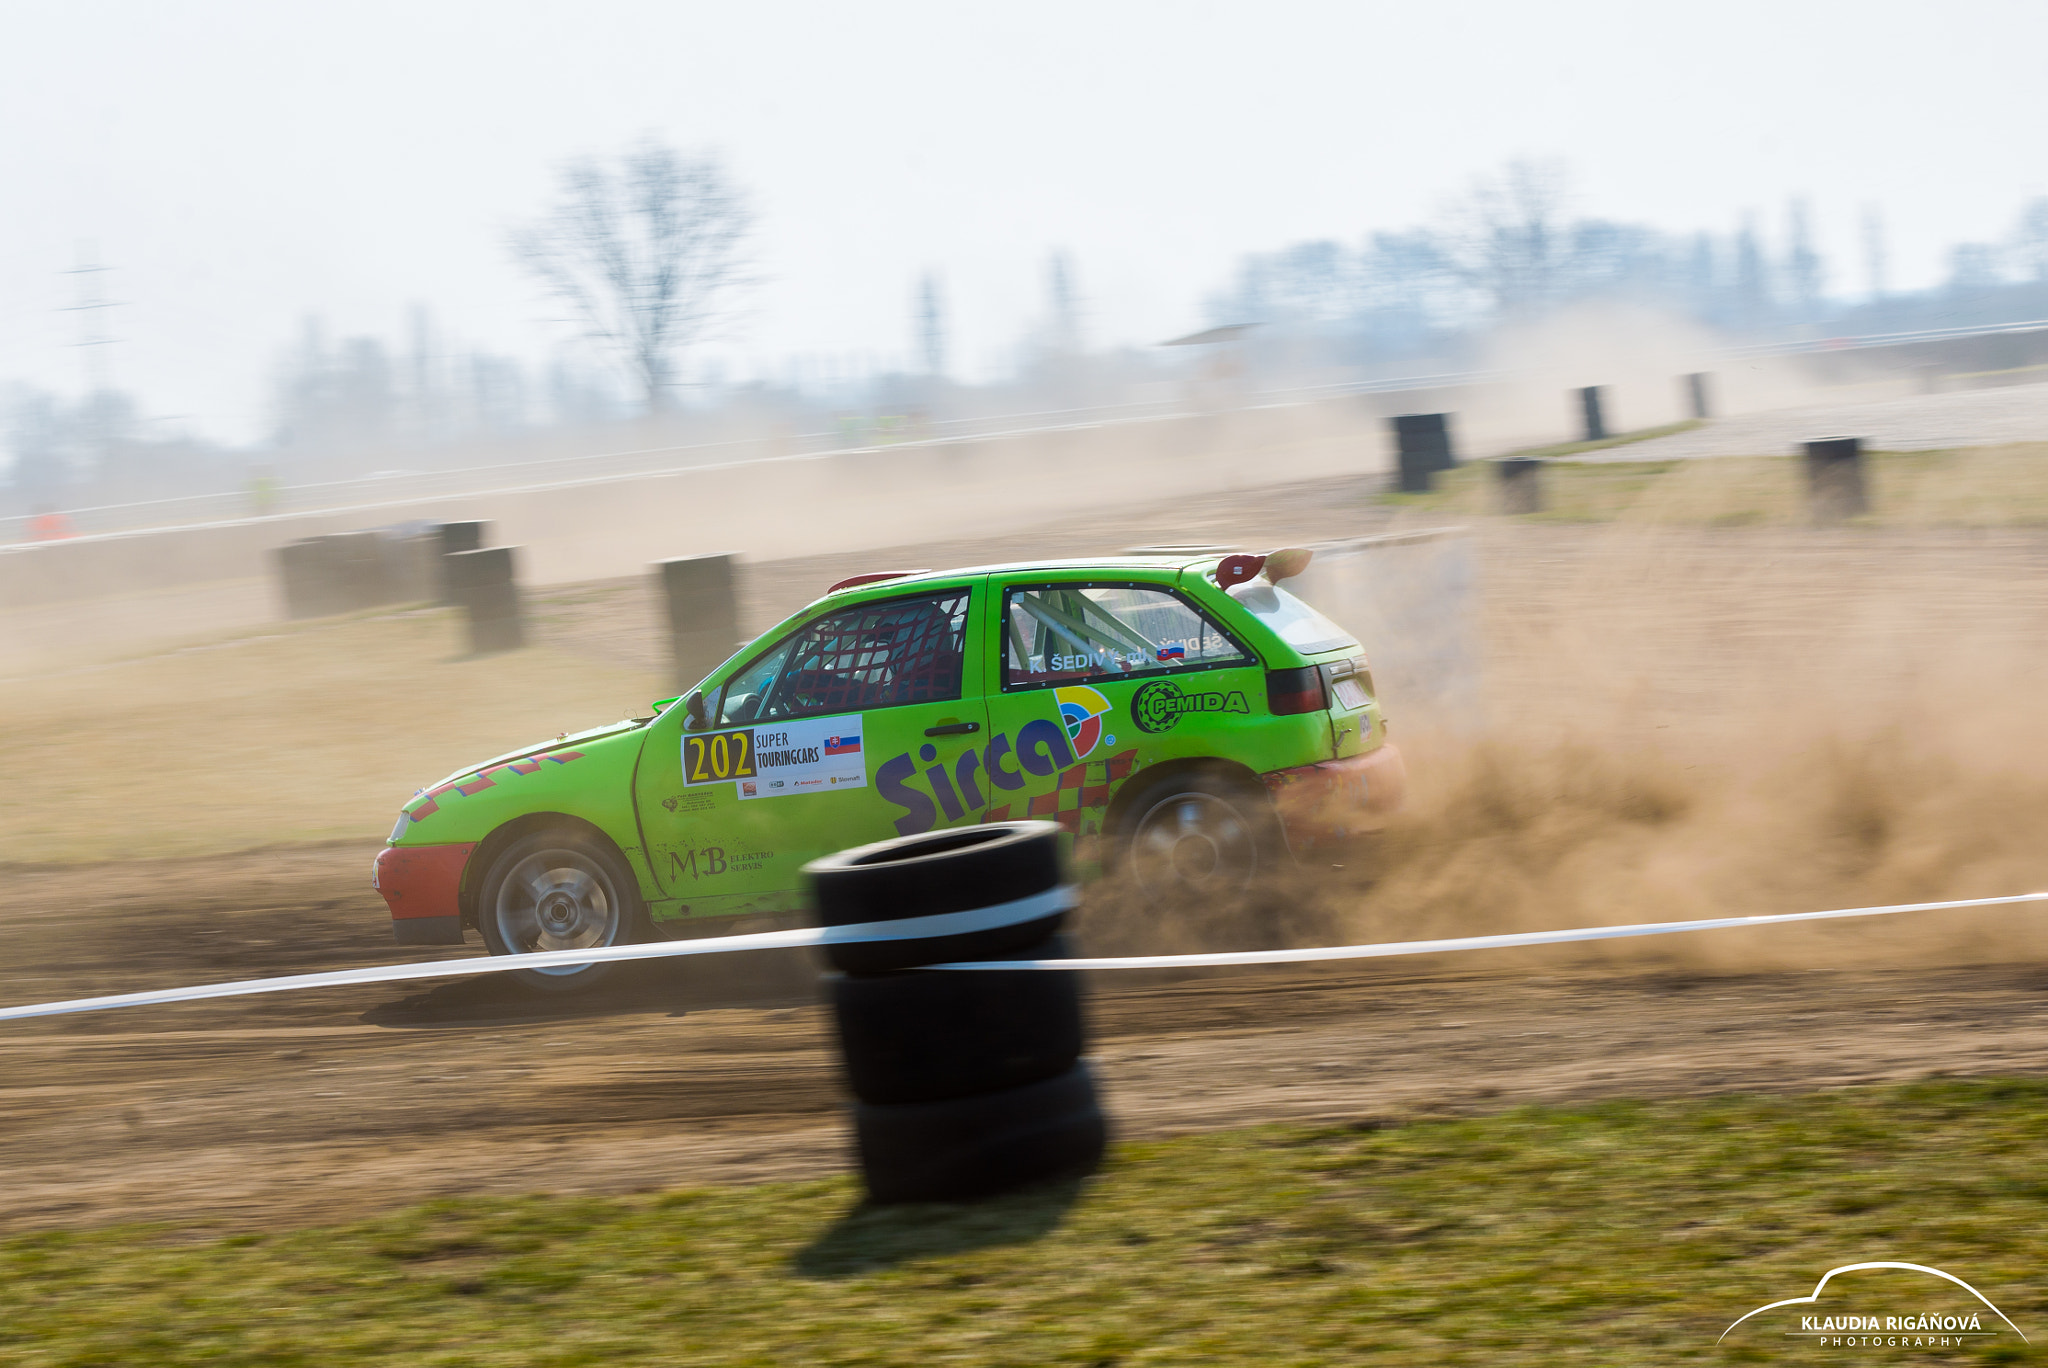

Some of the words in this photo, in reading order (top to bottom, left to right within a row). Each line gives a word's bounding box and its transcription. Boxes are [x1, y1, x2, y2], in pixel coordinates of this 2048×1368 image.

[1029, 659, 1047, 674] K.
[1051, 647, 1119, 671] ŠEDIVÝ
[1153, 690, 1250, 715] PEMIDA
[756, 732, 789, 749] SUPER
[689, 732, 752, 782] 202
[757, 746, 820, 769] TOURINGCARS
[875, 719, 1074, 838] Sirca
[668, 846, 727, 884] MB
[730, 850, 774, 863] ELEKTRO
[730, 861, 763, 873] SERVIS
